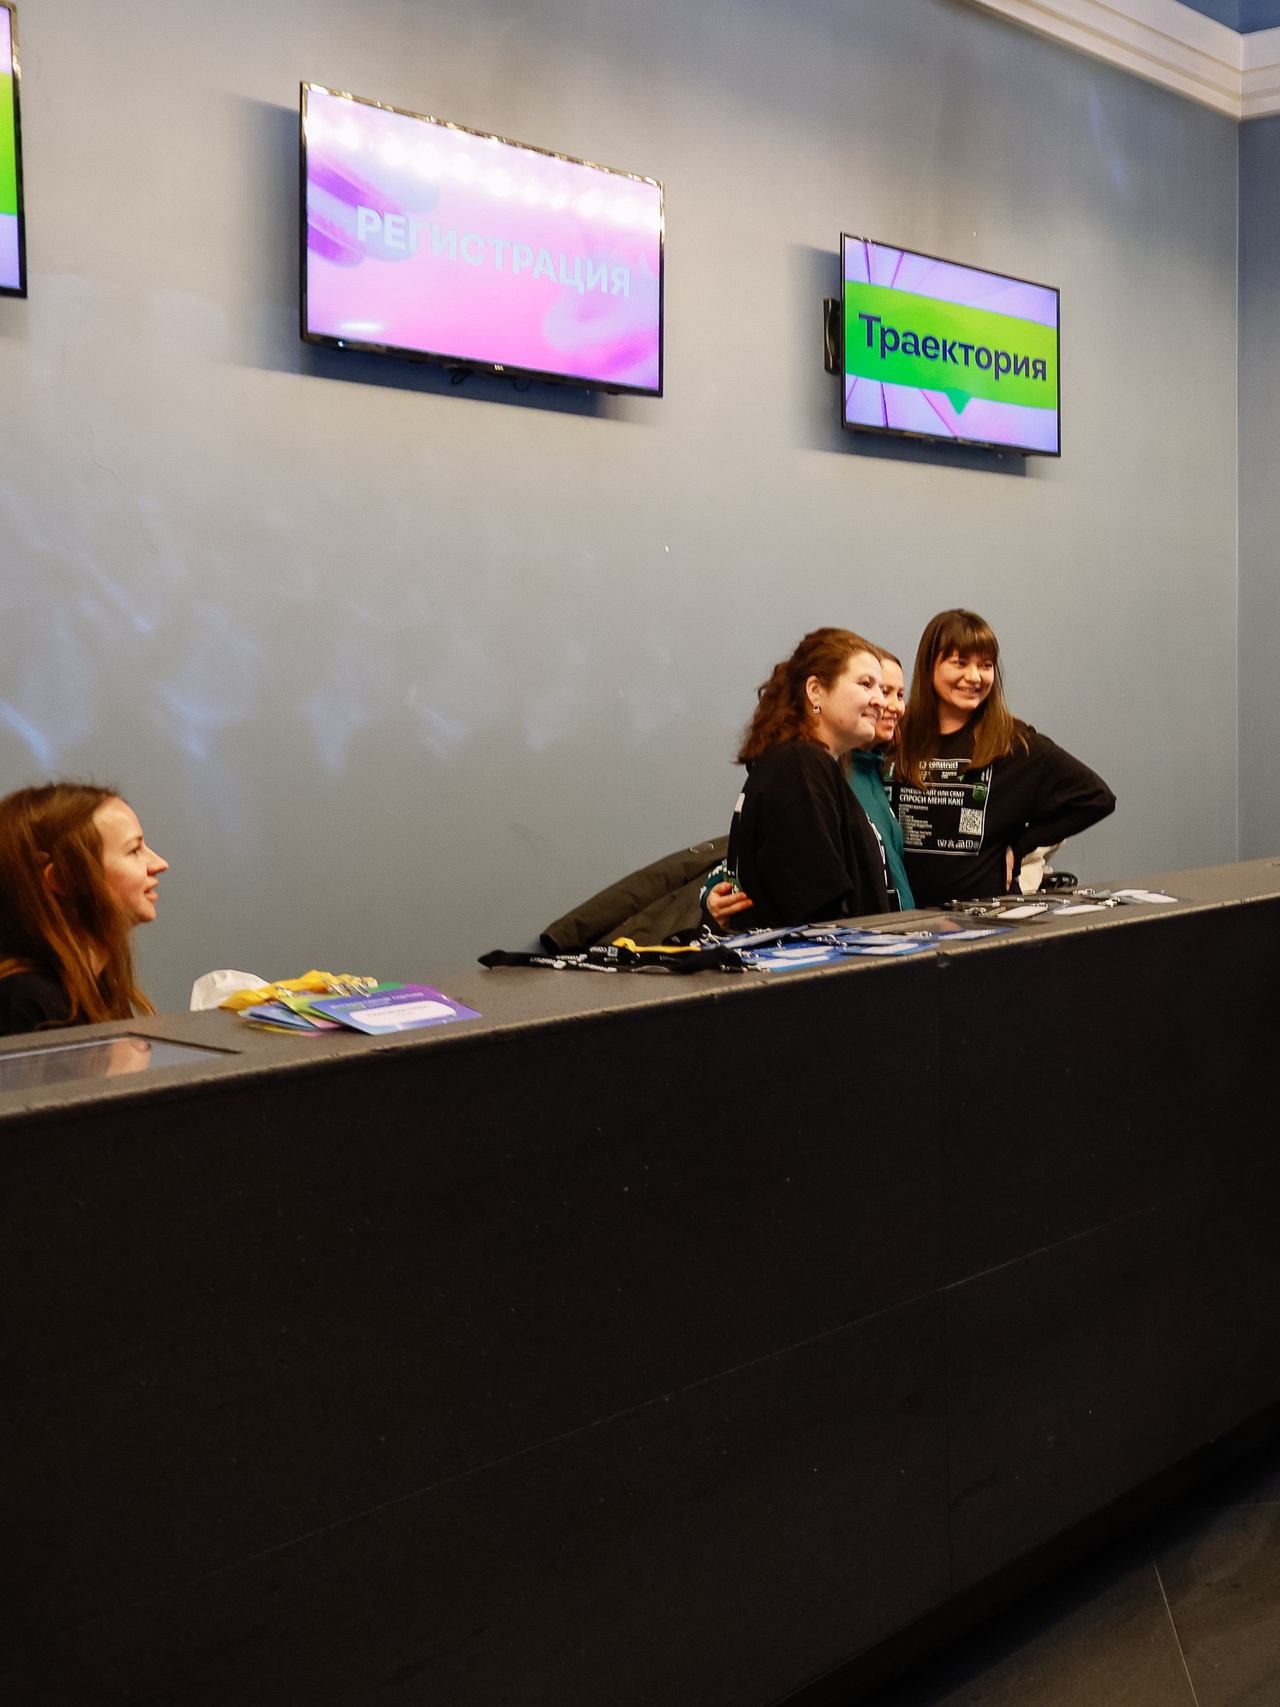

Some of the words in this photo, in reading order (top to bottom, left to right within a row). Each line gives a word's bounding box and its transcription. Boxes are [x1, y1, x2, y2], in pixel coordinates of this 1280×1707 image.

[355, 205, 632, 298] РЕГИСТРАЦИЯ
[858, 312, 1047, 381] Траектория
[899, 794, 926, 803] СПРОСИ
[927, 796, 947, 805] МЕНЯ
